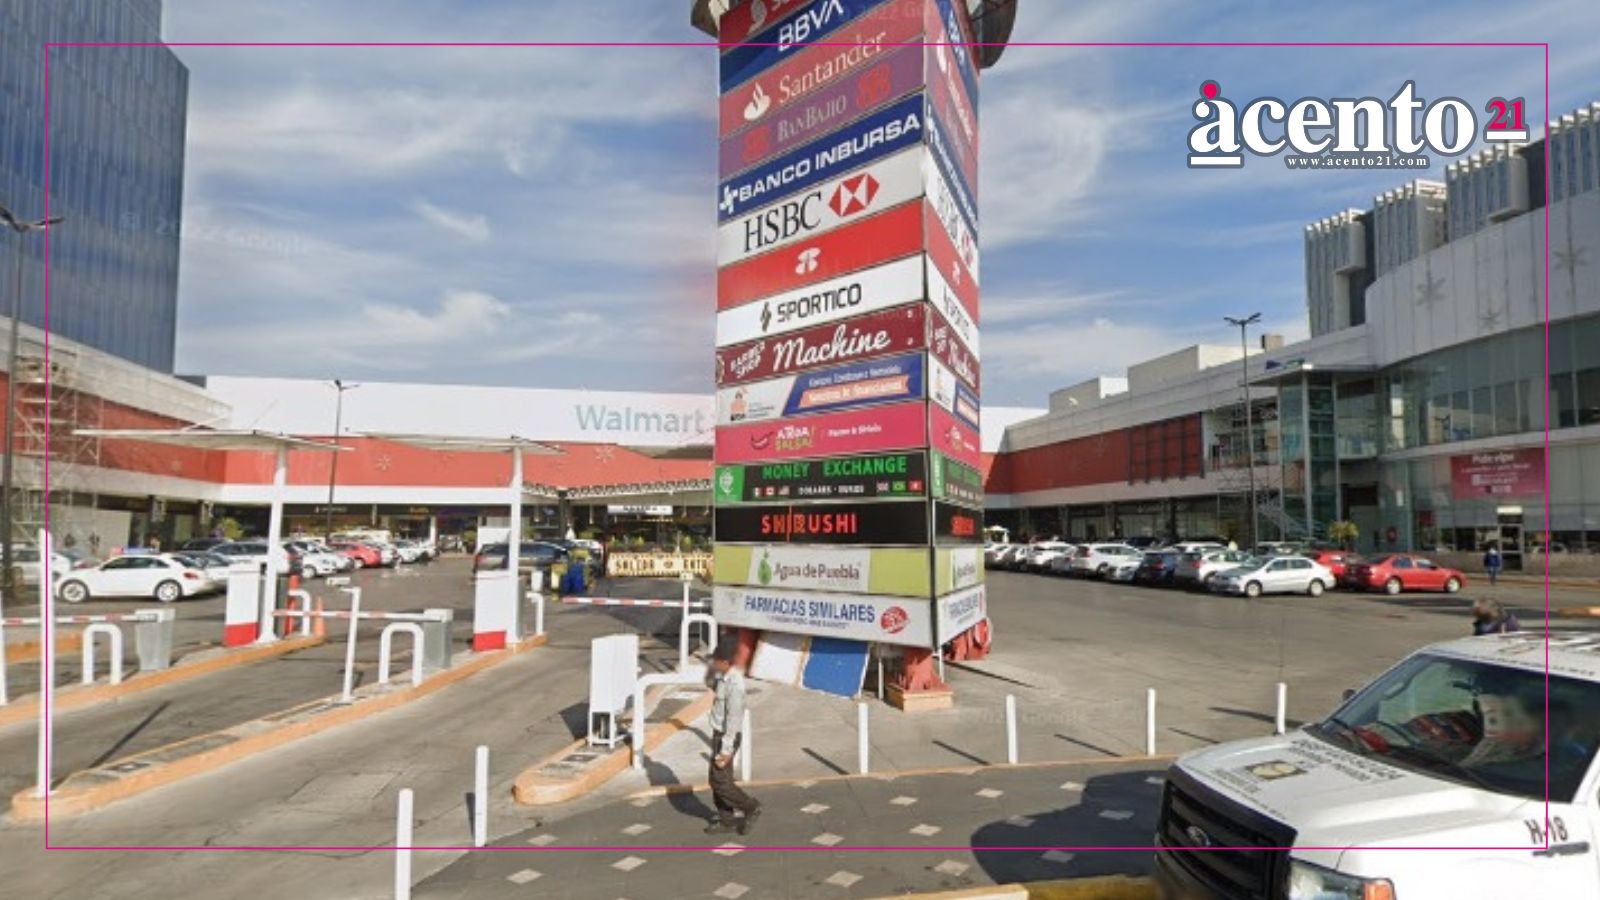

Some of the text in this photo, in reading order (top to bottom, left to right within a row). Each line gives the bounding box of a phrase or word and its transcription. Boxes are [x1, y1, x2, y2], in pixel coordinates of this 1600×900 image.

[778, 0, 843, 51] BBVA
[779, 30, 887, 104] Santander
[737, 113, 921, 201] BANCO INBURSA
[744, 192, 821, 252] HSBC
[776, 283, 862, 323] SPORTICO
[772, 324, 891, 372] Machine
[575, 403, 704, 435] Walmart
[762, 456, 907, 480] MONEY EXCHANGE
[775, 560, 861, 581] Agua de Puebla
[744, 594, 806, 617] FARMACIAS
[808, 600, 876, 624] SIMILARES
[1524, 814, 1568, 844] H-18
